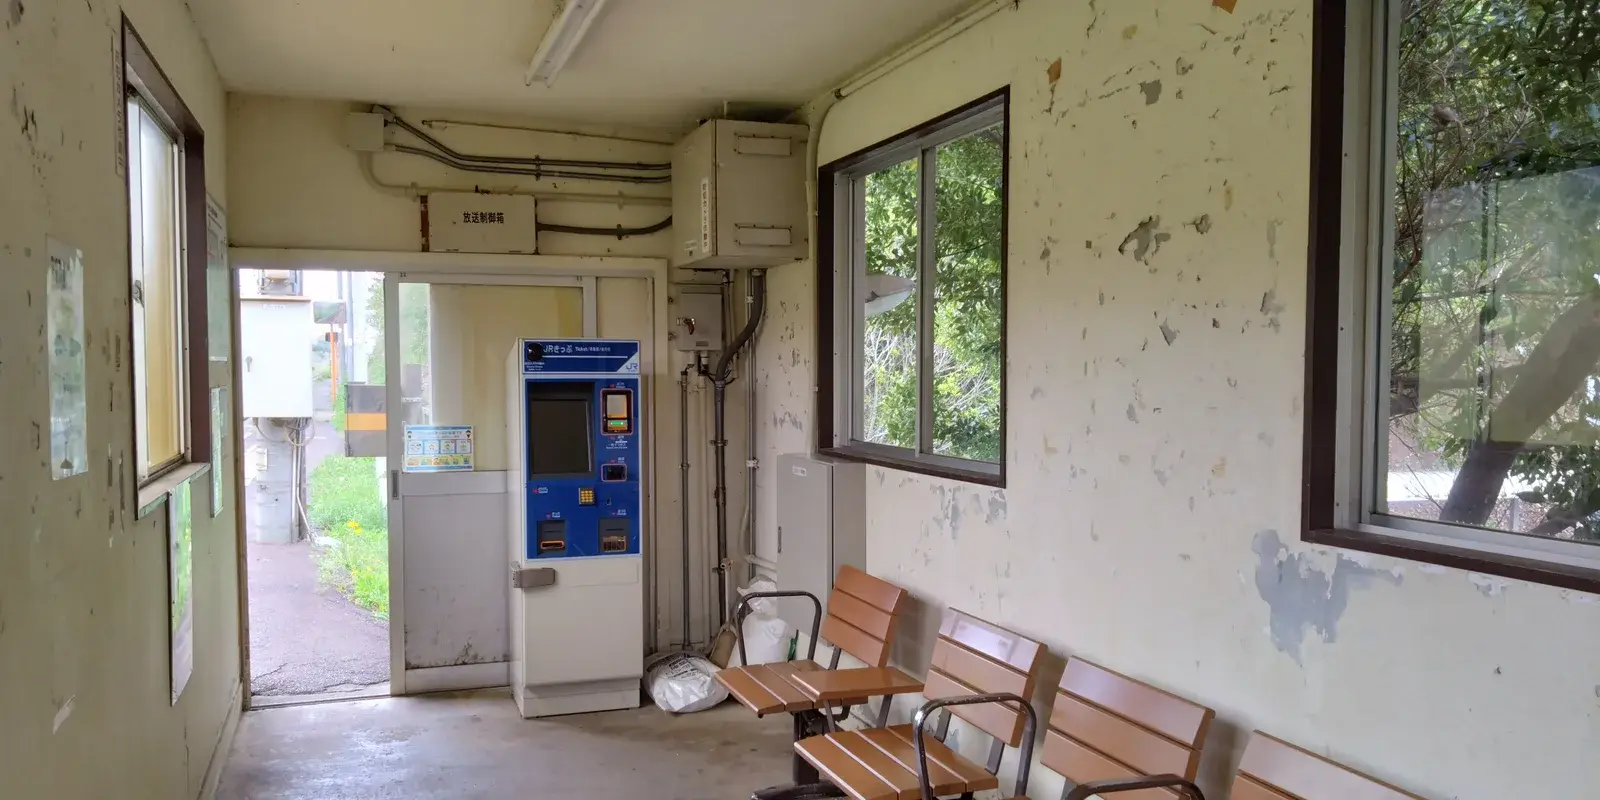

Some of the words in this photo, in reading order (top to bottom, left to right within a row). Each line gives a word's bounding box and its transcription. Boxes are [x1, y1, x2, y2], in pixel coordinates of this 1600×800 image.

[463, 211, 504, 224] 放送制御箱
[543, 345, 573, 354] JRきっぷ
[625, 362, 638, 370] JR
